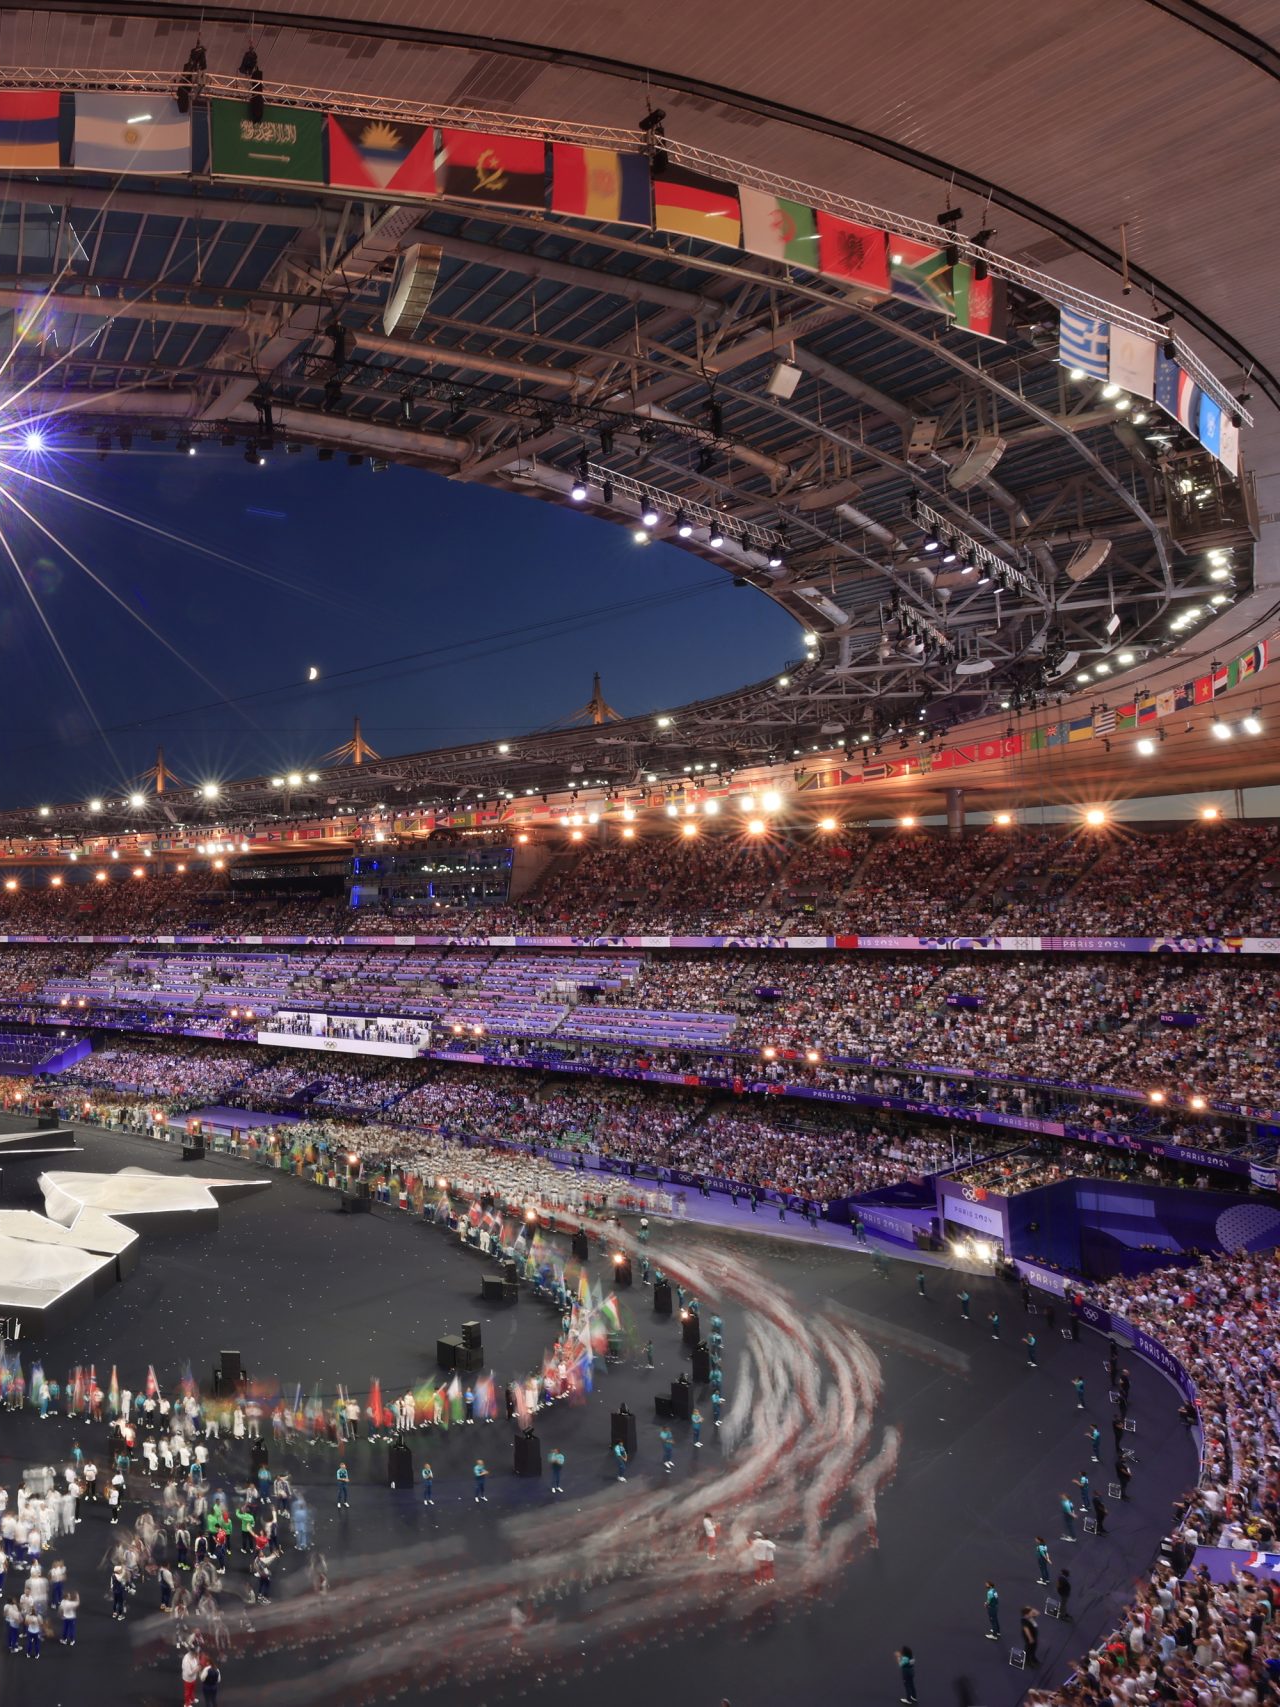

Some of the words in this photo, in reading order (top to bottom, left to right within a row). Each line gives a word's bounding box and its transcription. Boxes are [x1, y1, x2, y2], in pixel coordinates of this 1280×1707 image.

[1063, 940, 1094, 948] PARIS
[1097, 940, 1126, 948] 2024
[812, 1091, 834, 1099] PARIS
[836, 1092, 857, 1101] 2024
[998, 1116, 1021, 1126] PARIS
[1180, 1150, 1205, 1162] PARIS
[1207, 1157, 1229, 1168] 2024
[707, 1179, 733, 1190] PARIS
[858, 1210, 881, 1224] PARIS
[883, 1219, 905, 1234] 2024
[954, 1206, 973, 1217] PARIS
[974, 1211, 992, 1224] 2024
[1029, 1270, 1059, 1288] PARIS
[1139, 1337, 1160, 1360] PARIS
[1161, 1352, 1177, 1375] 2024
